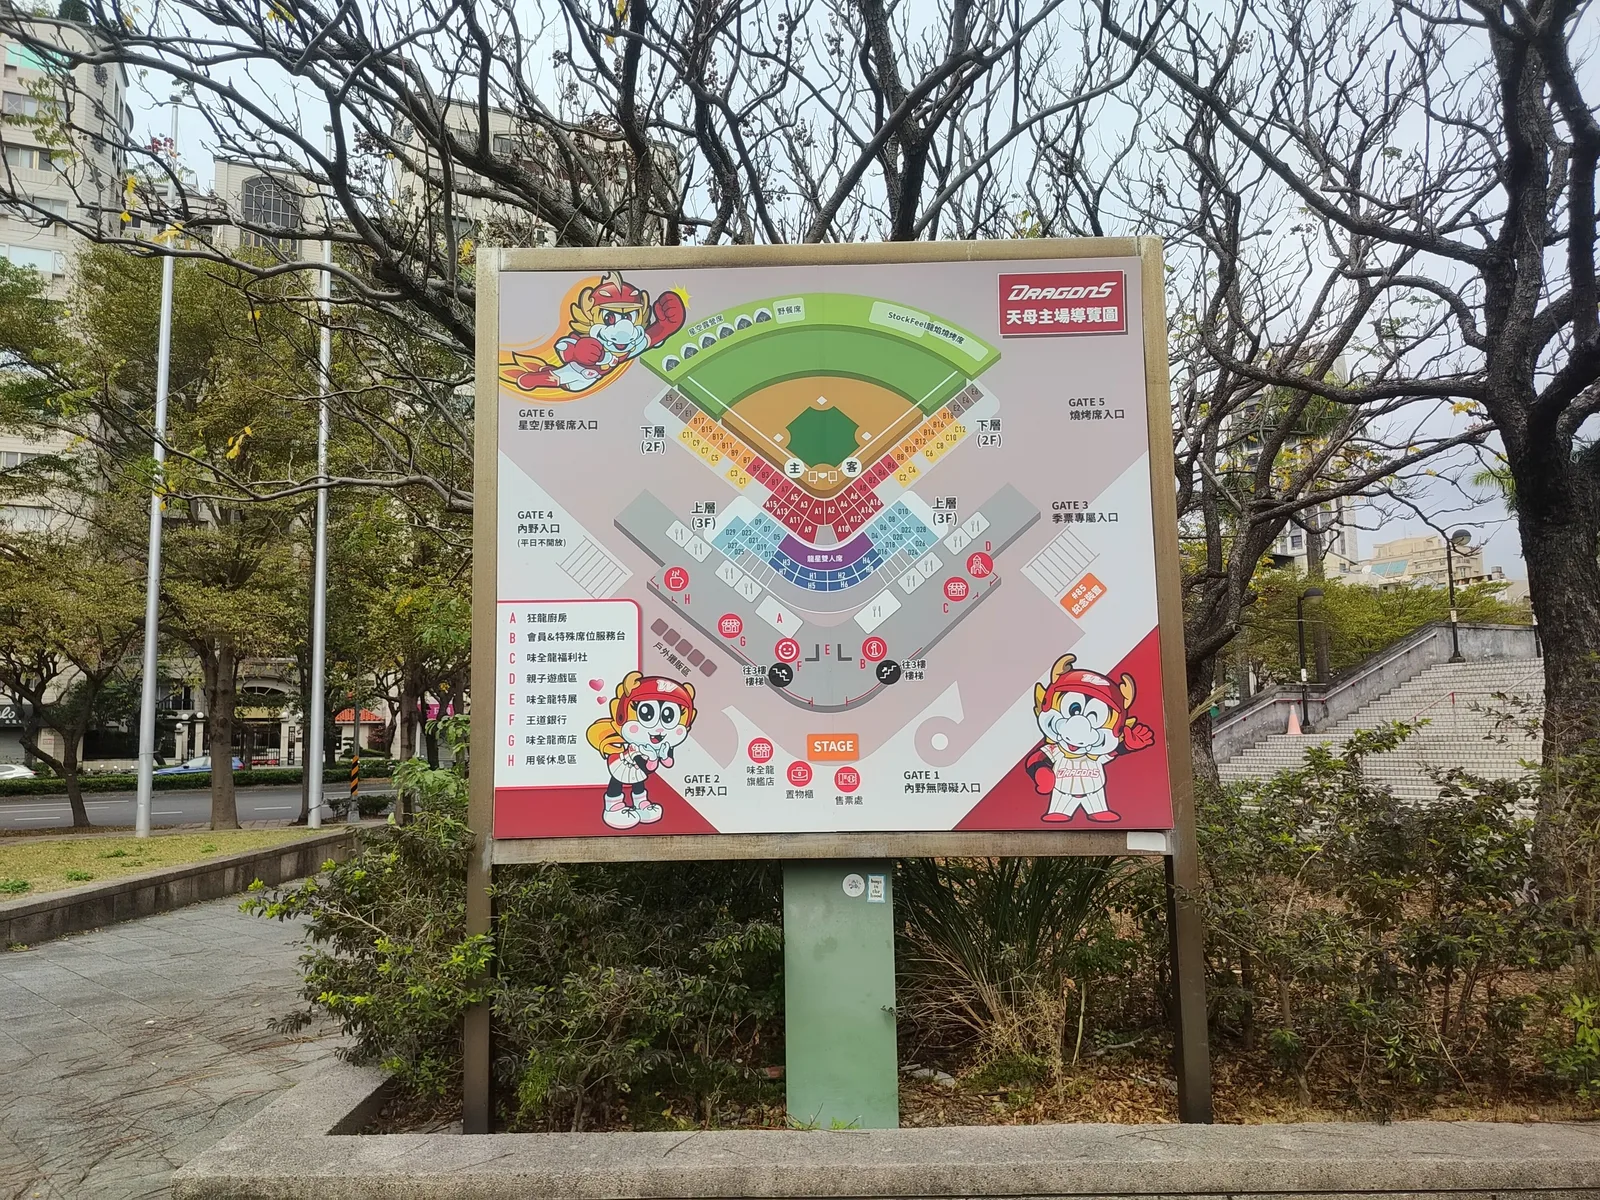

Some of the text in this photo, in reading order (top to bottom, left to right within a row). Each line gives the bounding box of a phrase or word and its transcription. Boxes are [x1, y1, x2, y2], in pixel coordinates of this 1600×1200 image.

[777, 306, 801, 315] 野餐席
[1007, 307, 1118, 325] 天母主場導覽圖
[1069, 398, 1105, 406] GATE 5
[1070, 410, 1124, 420] 燒烤席入口
[518, 420, 598, 431] 星空/野餐席入口
[977, 420, 1000, 431] 下層
[641, 426, 665, 438] 下層
[977, 436, 1001, 447] (2F)
[641, 442, 665, 454] (2F)
[789, 463, 800, 473] 主
[846, 461, 857, 472] 客
[692, 502, 715, 514] 上層
[932, 498, 956, 509] 上層
[1052, 501, 1088, 510] GATE 3
[518, 511, 553, 519] GATE 4
[933, 513, 957, 525] (3F)
[1052, 513, 1118, 523] 季票專屬入口
[692, 517, 715, 530] (3F)
[518, 538, 566, 547] (平日不開放)
[986, 541, 991, 551] D
[807, 555, 843, 563] 龍星雙人席
[1071, 585, 1087, 599] #85
[685, 594, 690, 604] H
[1072, 585, 1102, 615] 紀念裝置
[943, 603, 948, 613] C
[510, 613, 567, 623] A 狂龍廚房
[777, 613, 782, 623] A
[510, 631, 625, 643] B 會員&特殊席位服務台
[740, 637, 745, 646] G
[825, 645, 830, 655] E
[510, 652, 587, 664] C 味全龍福利社
[797, 661, 802, 671] F
[860, 659, 865, 669] B
[902, 661, 926, 669] 往3樓
[743, 666, 766, 674] 往3樓
[510, 673, 577, 684] D 親子遊戲區
[905, 672, 923, 680] 樓梯
[746, 678, 764, 686] 樓梯
[510, 694, 577, 705] E 味全龍特展
[509, 715, 567, 725] F 王道銀行
[509, 735, 577, 746] G 味全龍商店
[814, 741, 853, 752] STAGE
[508, 755, 577, 766] H 用餐休息區
[747, 766, 774, 775] 味全龍
[904, 771, 939, 780] GATE 1
[684, 775, 720, 783] GATE 2
[747, 777, 774, 786] 旗艦店
[786, 790, 813, 799] 置物櫃
[835, 796, 863, 805] 售票處
